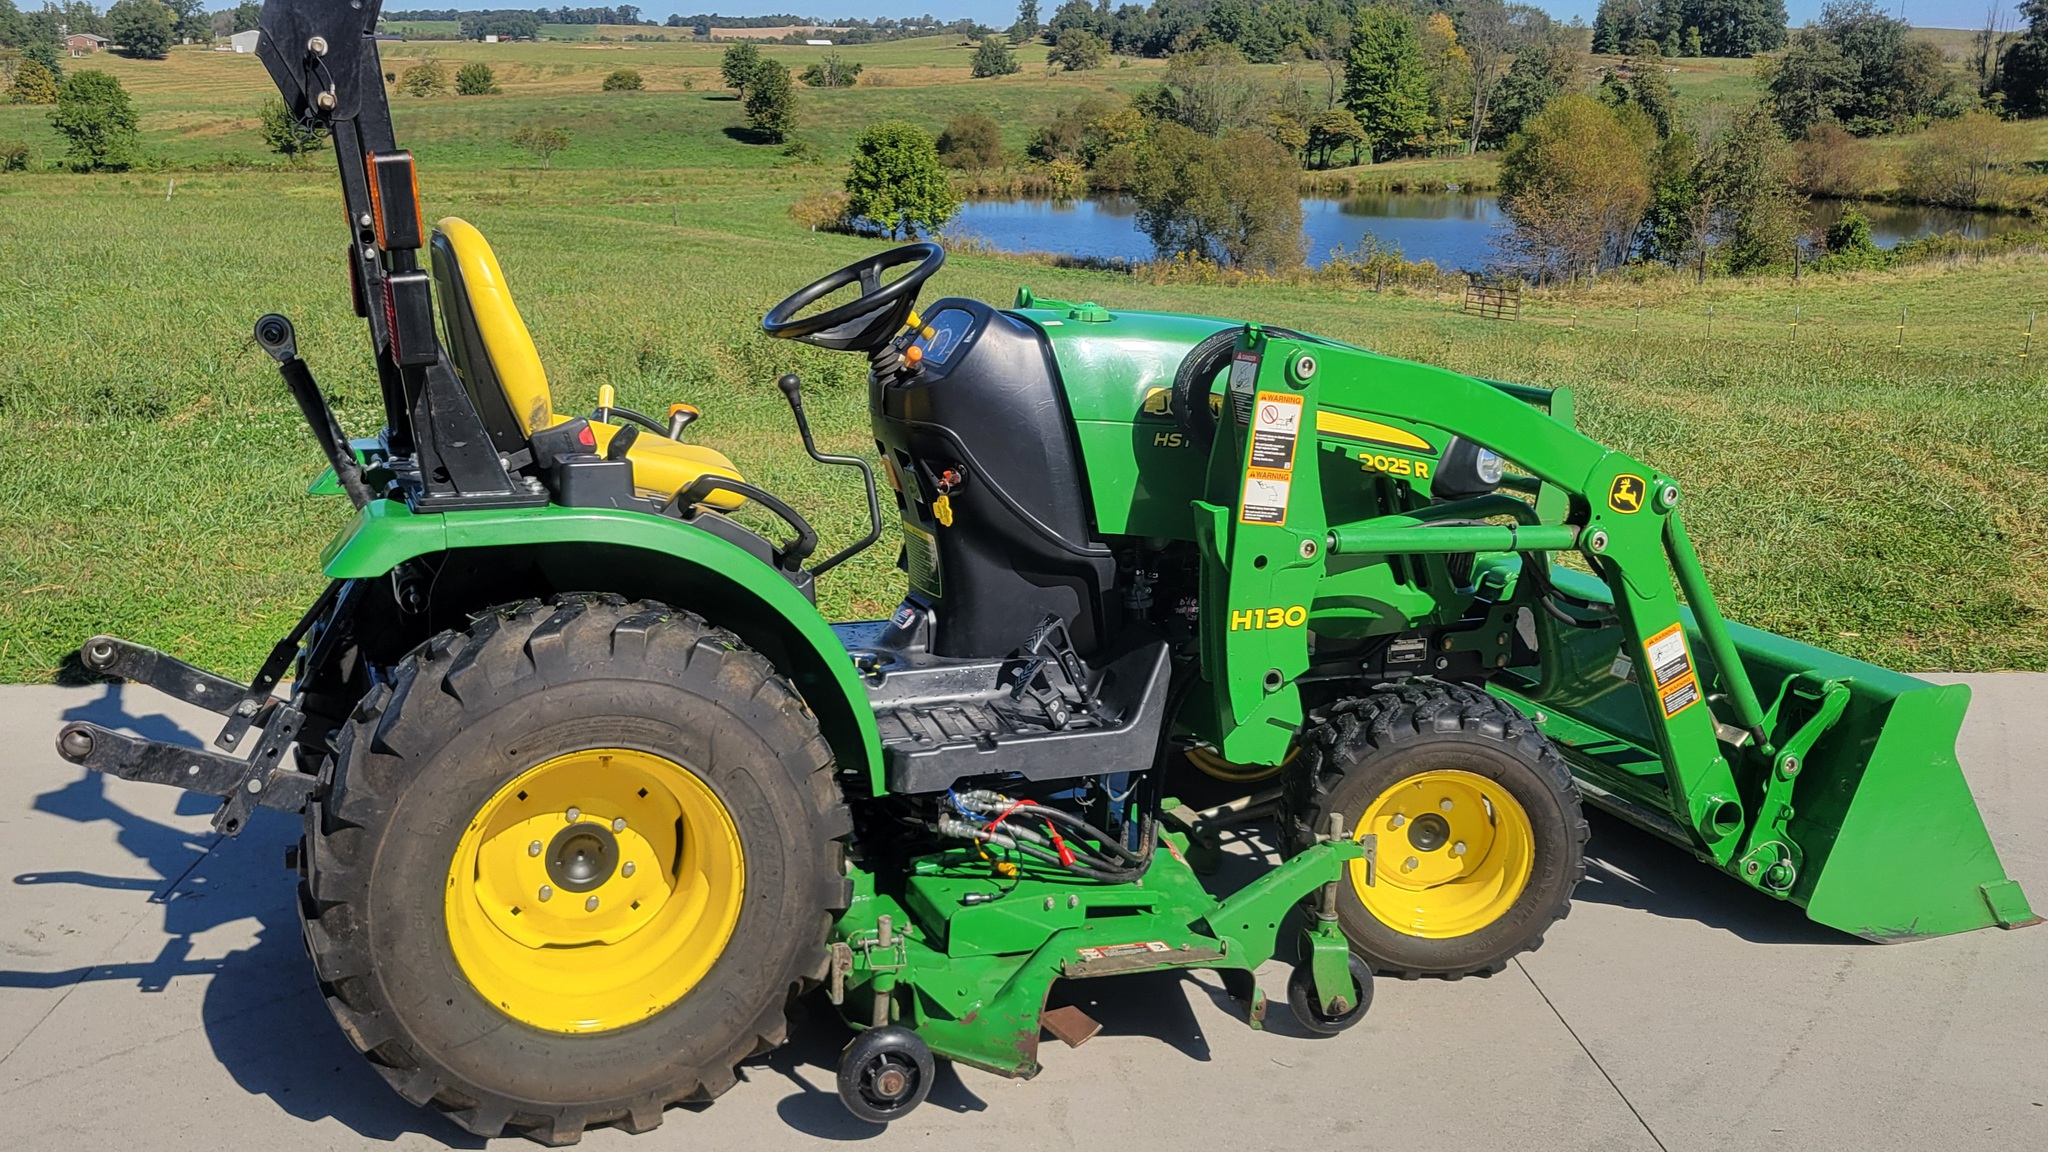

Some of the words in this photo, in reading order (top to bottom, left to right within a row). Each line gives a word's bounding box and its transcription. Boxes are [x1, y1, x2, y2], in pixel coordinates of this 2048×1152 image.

[1267, 394, 1301, 404] WARNING
[1359, 453, 1411, 475] 2025
[1414, 461, 1429, 479] R
[1256, 471, 1289, 480] WARNING
[1230, 605, 1307, 631] H130
[1654, 627, 1676, 642] WARNING
[1669, 677, 1691, 692] WARNING
